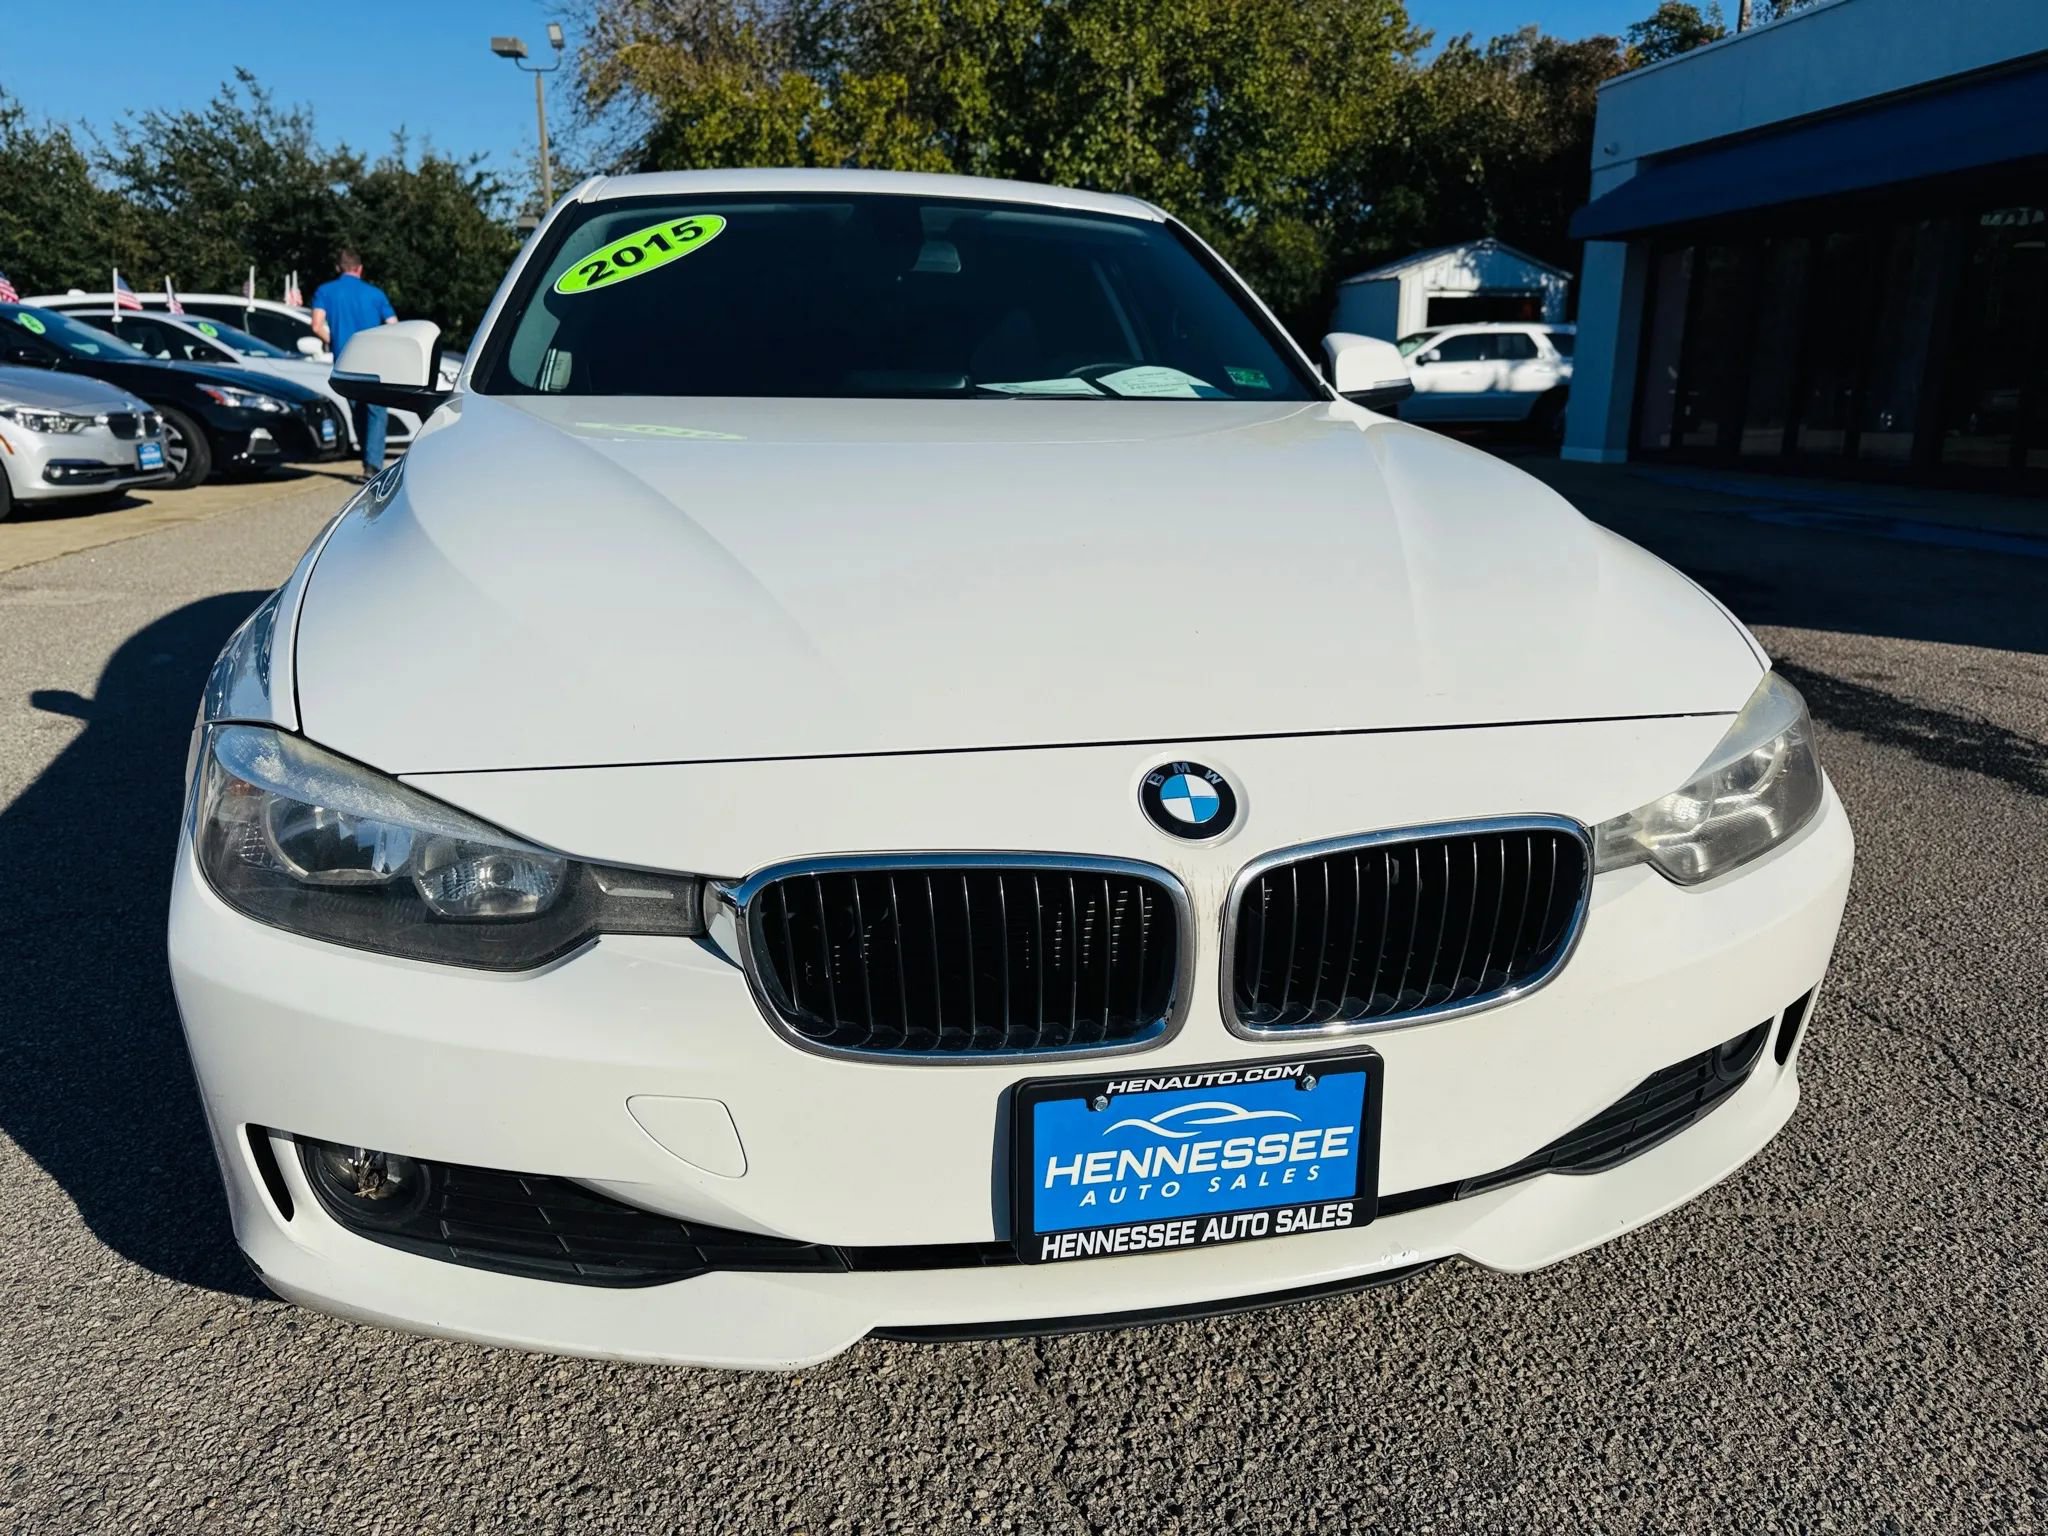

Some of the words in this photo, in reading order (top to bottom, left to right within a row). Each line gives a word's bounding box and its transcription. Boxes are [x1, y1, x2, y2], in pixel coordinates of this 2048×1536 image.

[579, 220, 703, 286] 2015
[1147, 763, 1223, 787] BMW
[1106, 1064, 1305, 1095] HENAUTO.COM
[1044, 1125, 1354, 1189] HENNESSEE
[1079, 1181, 1180, 1208] AUTO
[1208, 1165, 1320, 1193] SALES
[1041, 1219, 1198, 1261] HENNESSEE
[1200, 1212, 1269, 1243] AUTO
[1274, 1202, 1354, 1234] SALES
